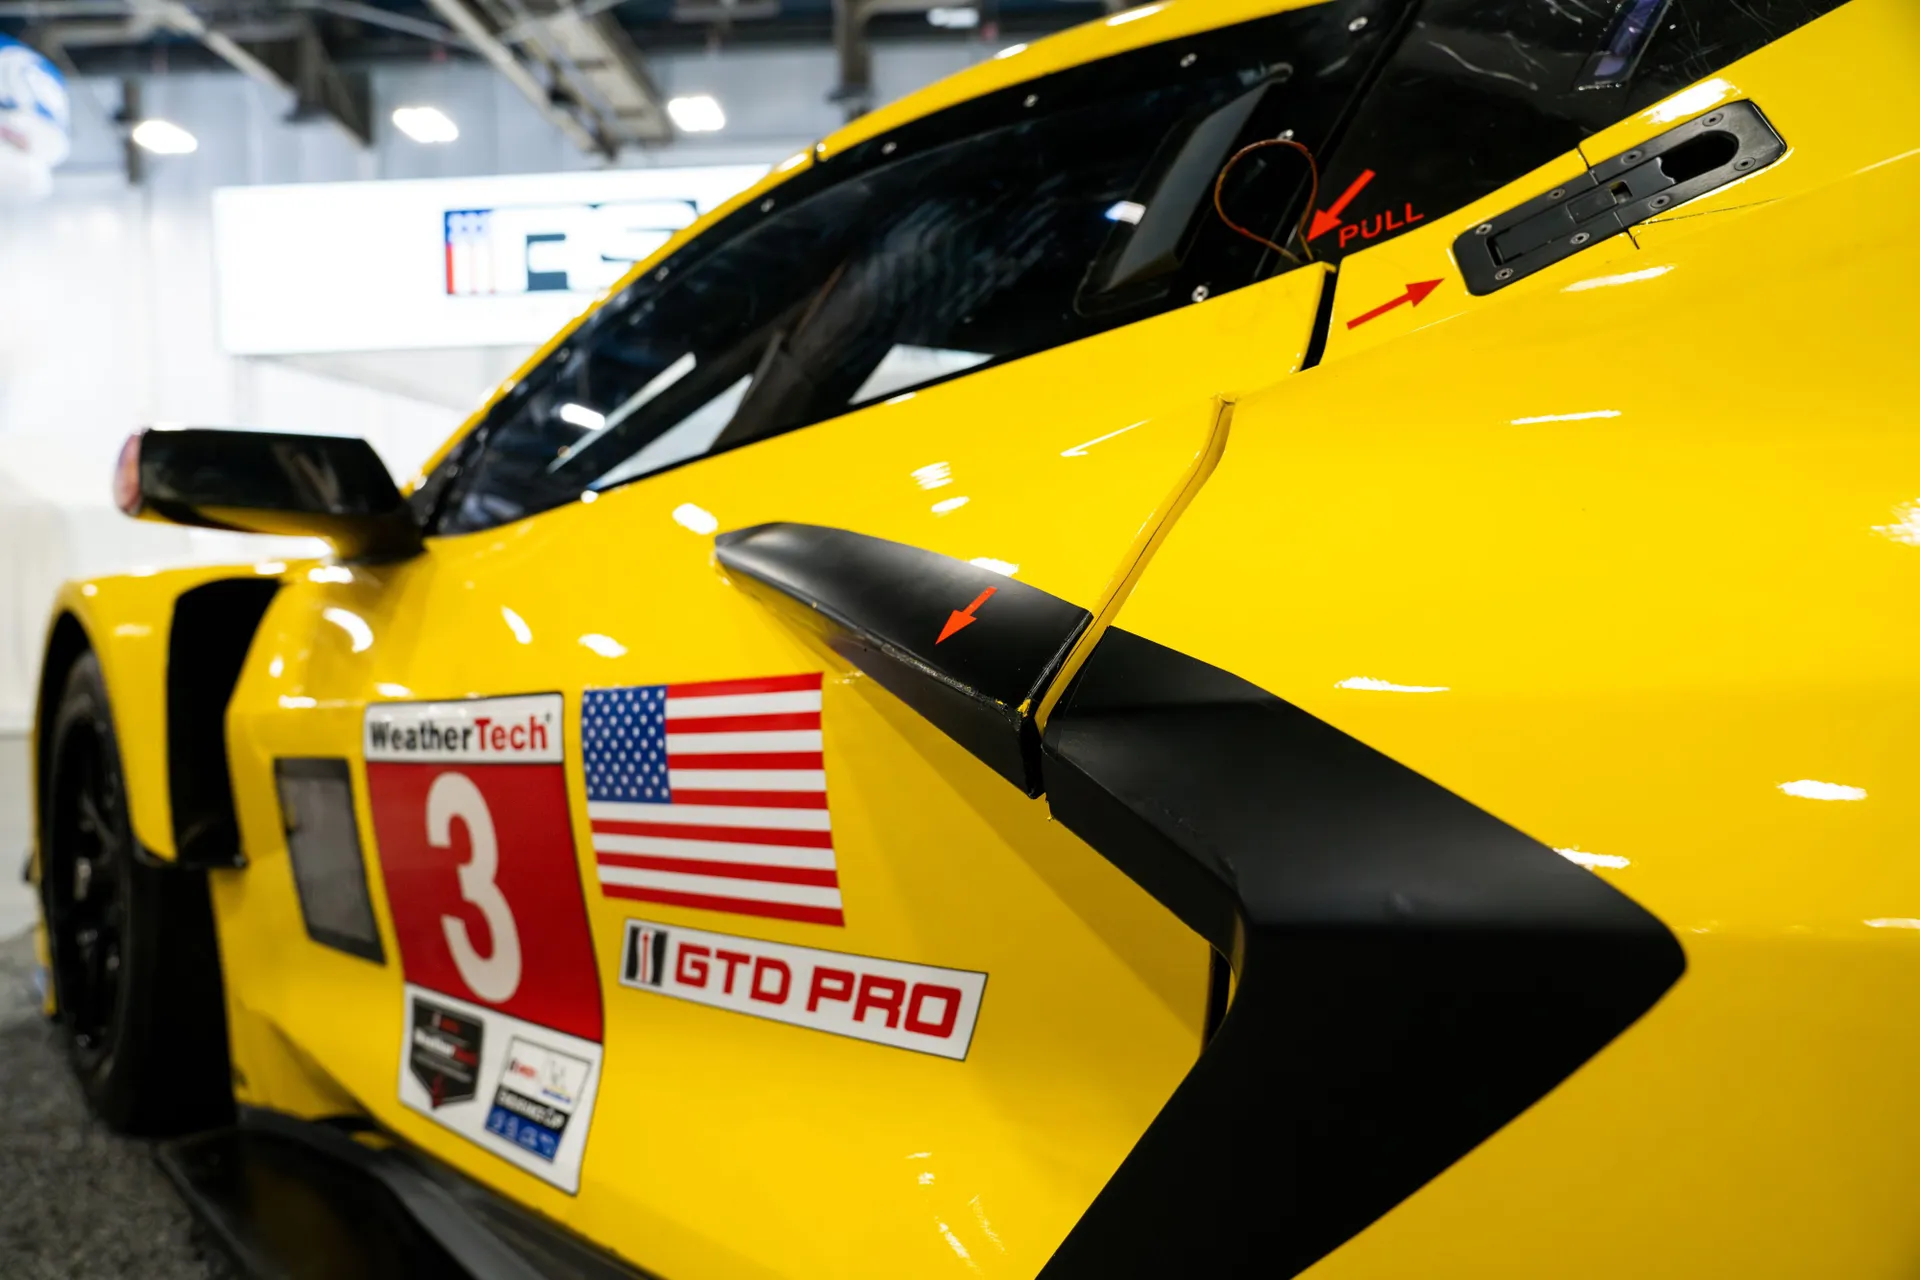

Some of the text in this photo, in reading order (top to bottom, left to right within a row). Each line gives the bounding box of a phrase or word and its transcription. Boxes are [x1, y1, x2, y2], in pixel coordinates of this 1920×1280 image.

[1339, 202, 1425, 249] PULL
[369, 714, 549, 751] WeatherTech
[425, 771, 523, 1004] 3
[675, 941, 962, 1039] GTD PRO
